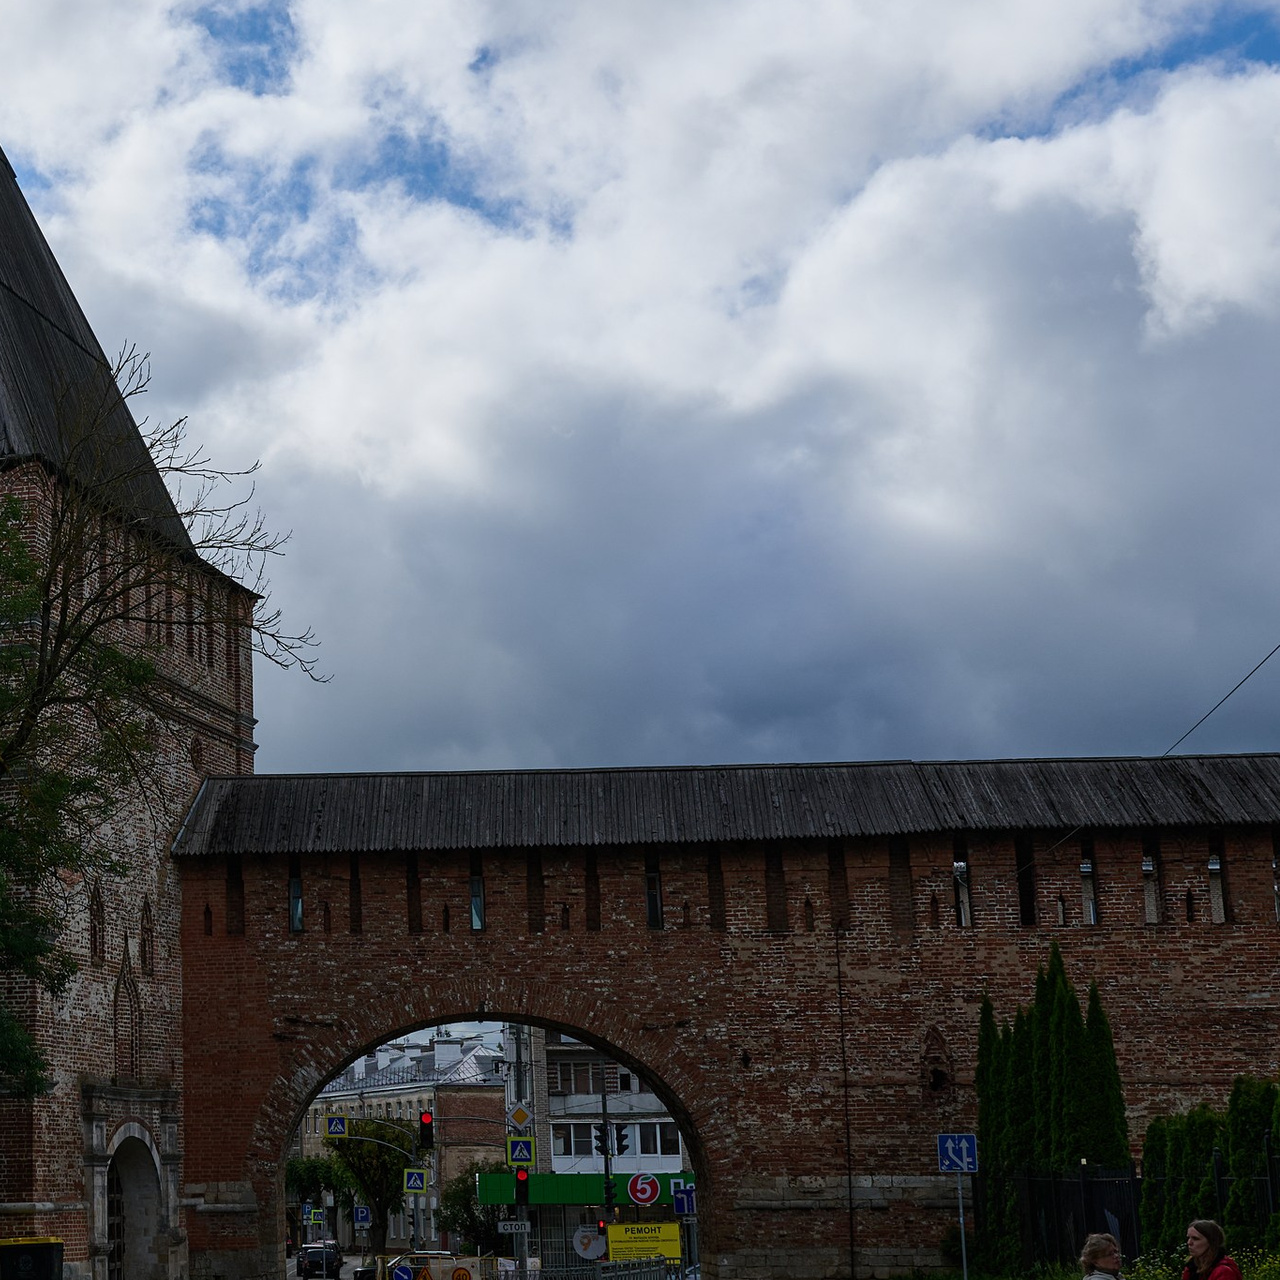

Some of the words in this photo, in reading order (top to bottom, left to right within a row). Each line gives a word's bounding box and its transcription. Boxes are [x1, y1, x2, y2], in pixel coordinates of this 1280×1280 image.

[358, 1208, 367, 1221] P
[502, 1223, 527, 1232] СТОП
[624, 1226, 662, 1235] РЕМОНТ
